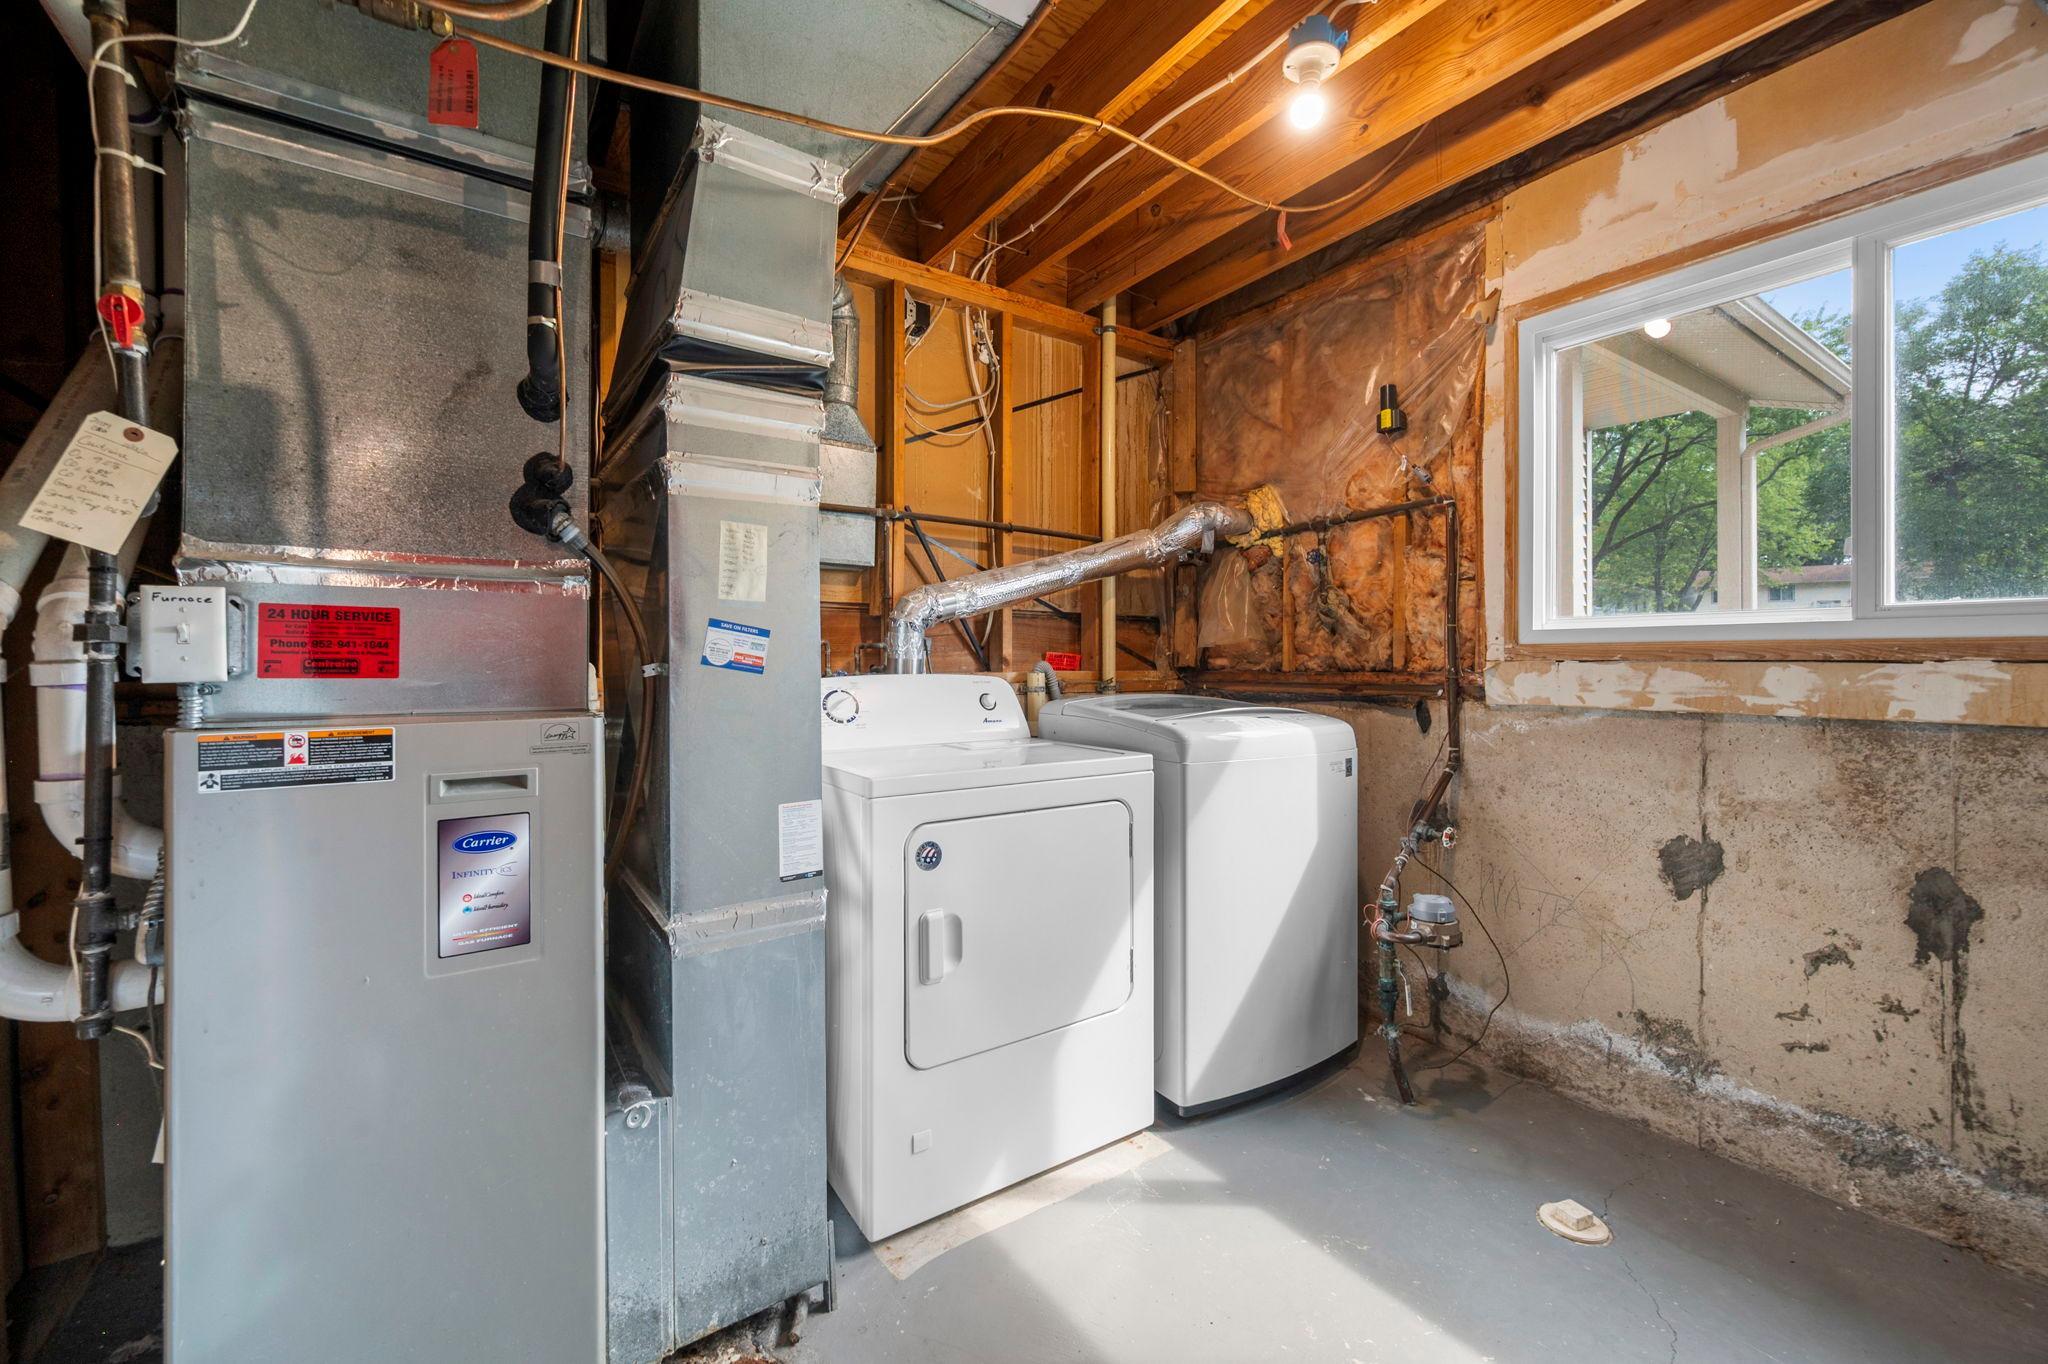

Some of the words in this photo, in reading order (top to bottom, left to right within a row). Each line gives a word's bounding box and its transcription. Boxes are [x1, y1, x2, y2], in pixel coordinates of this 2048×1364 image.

[151, 591, 213, 604] Furnace
[267, 608, 286, 620] 24
[291, 609, 330, 621] HOUR
[335, 610, 393, 623] SERVICE
[720, 622, 733, 630] SAVE
[741, 626, 759, 635] FILTERS
[270, 638, 308, 648] Phone
[311, 639, 333, 649] 952
[462, 836, 510, 848] Carrier
[451, 868, 494, 880] INFINITY
[476, 934, 513, 943] FURNACE
